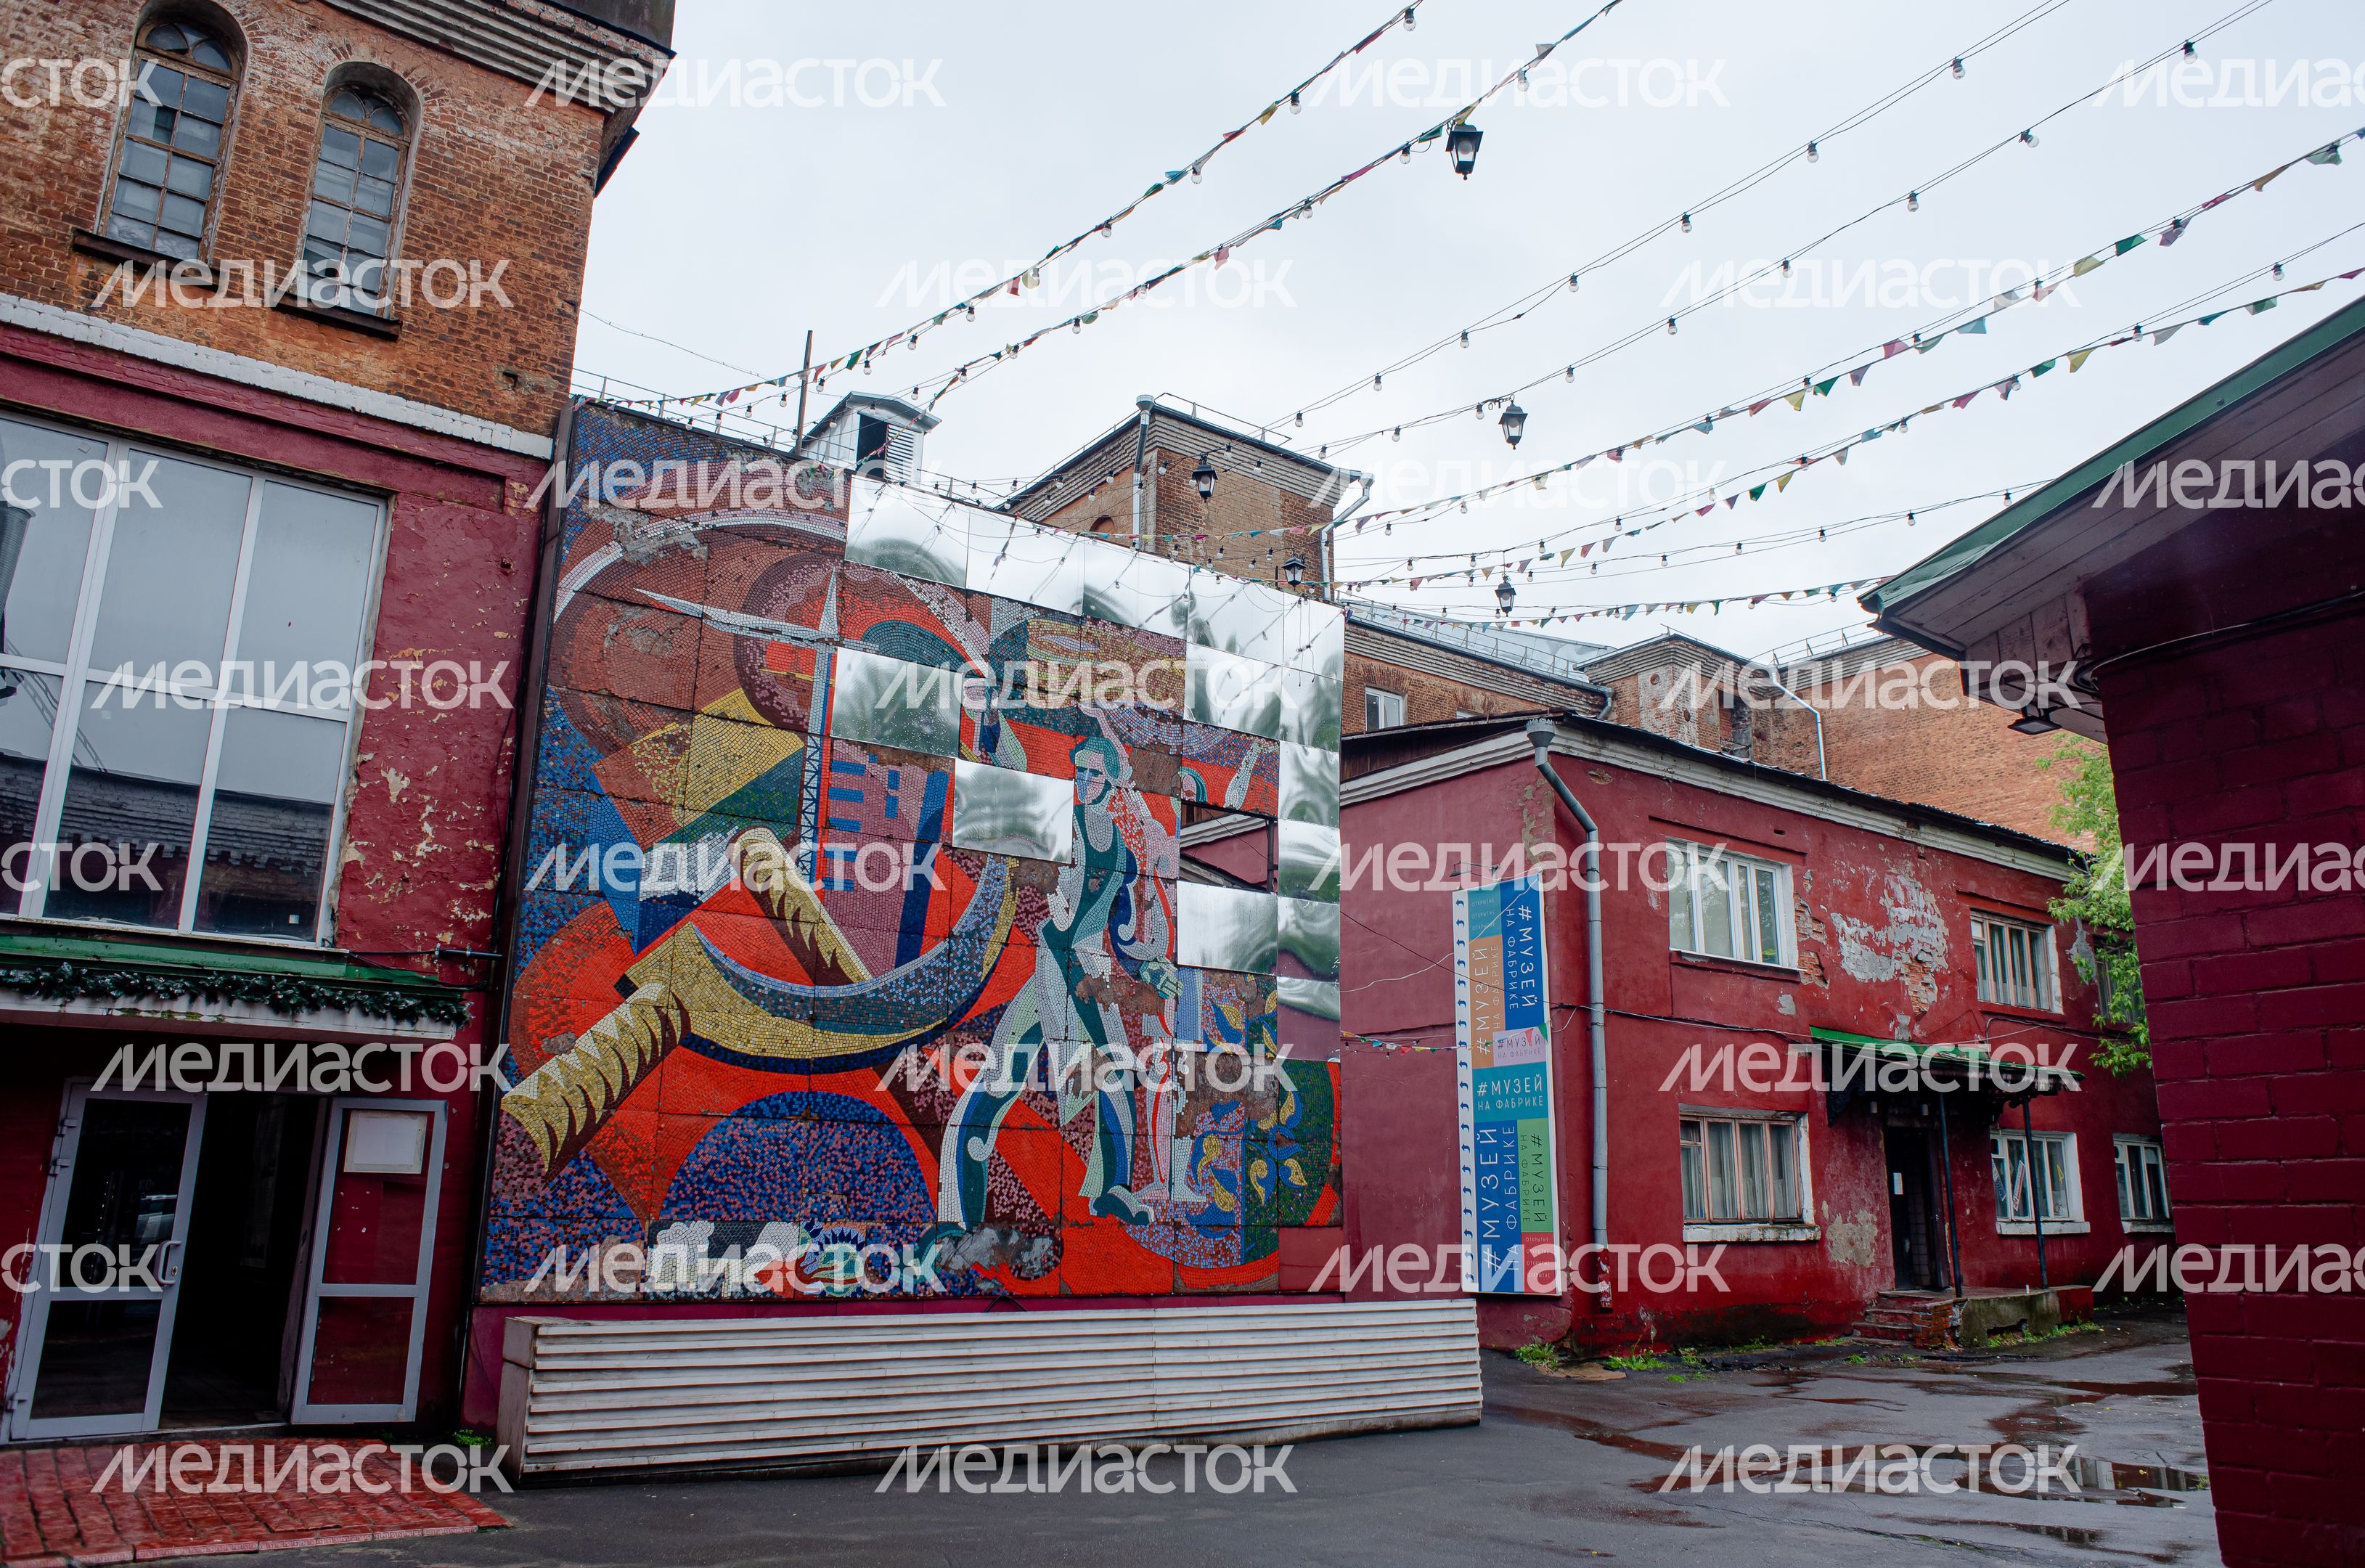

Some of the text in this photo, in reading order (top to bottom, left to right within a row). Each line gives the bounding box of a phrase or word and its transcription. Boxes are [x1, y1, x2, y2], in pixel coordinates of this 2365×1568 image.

[1471, 947, 1490, 1055] #МУЗЕЙ
[1491, 945, 1500, 1029] НА ФАБРИКЕ
[1506, 908, 1519, 1010] НА ФАБРИКЕ
[1519, 905, 1535, 1008] #МУЗЕЙ
[1477, 1074, 1543, 1097] #МУЗЕЙ
[1510, 1049, 1541, 1058] ФАБРИКЕ
[1478, 1095, 1543, 1111] НА ФАБРИКЕ
[1476, 1128, 1502, 1271] #МУЗЕЙ
[1503, 1126, 1519, 1270] НА ФАБРИКЕ
[1520, 1135, 1531, 1224] НА ФАБРИКЕ
[1530, 1134, 1547, 1222] #МУЗЕЙ
